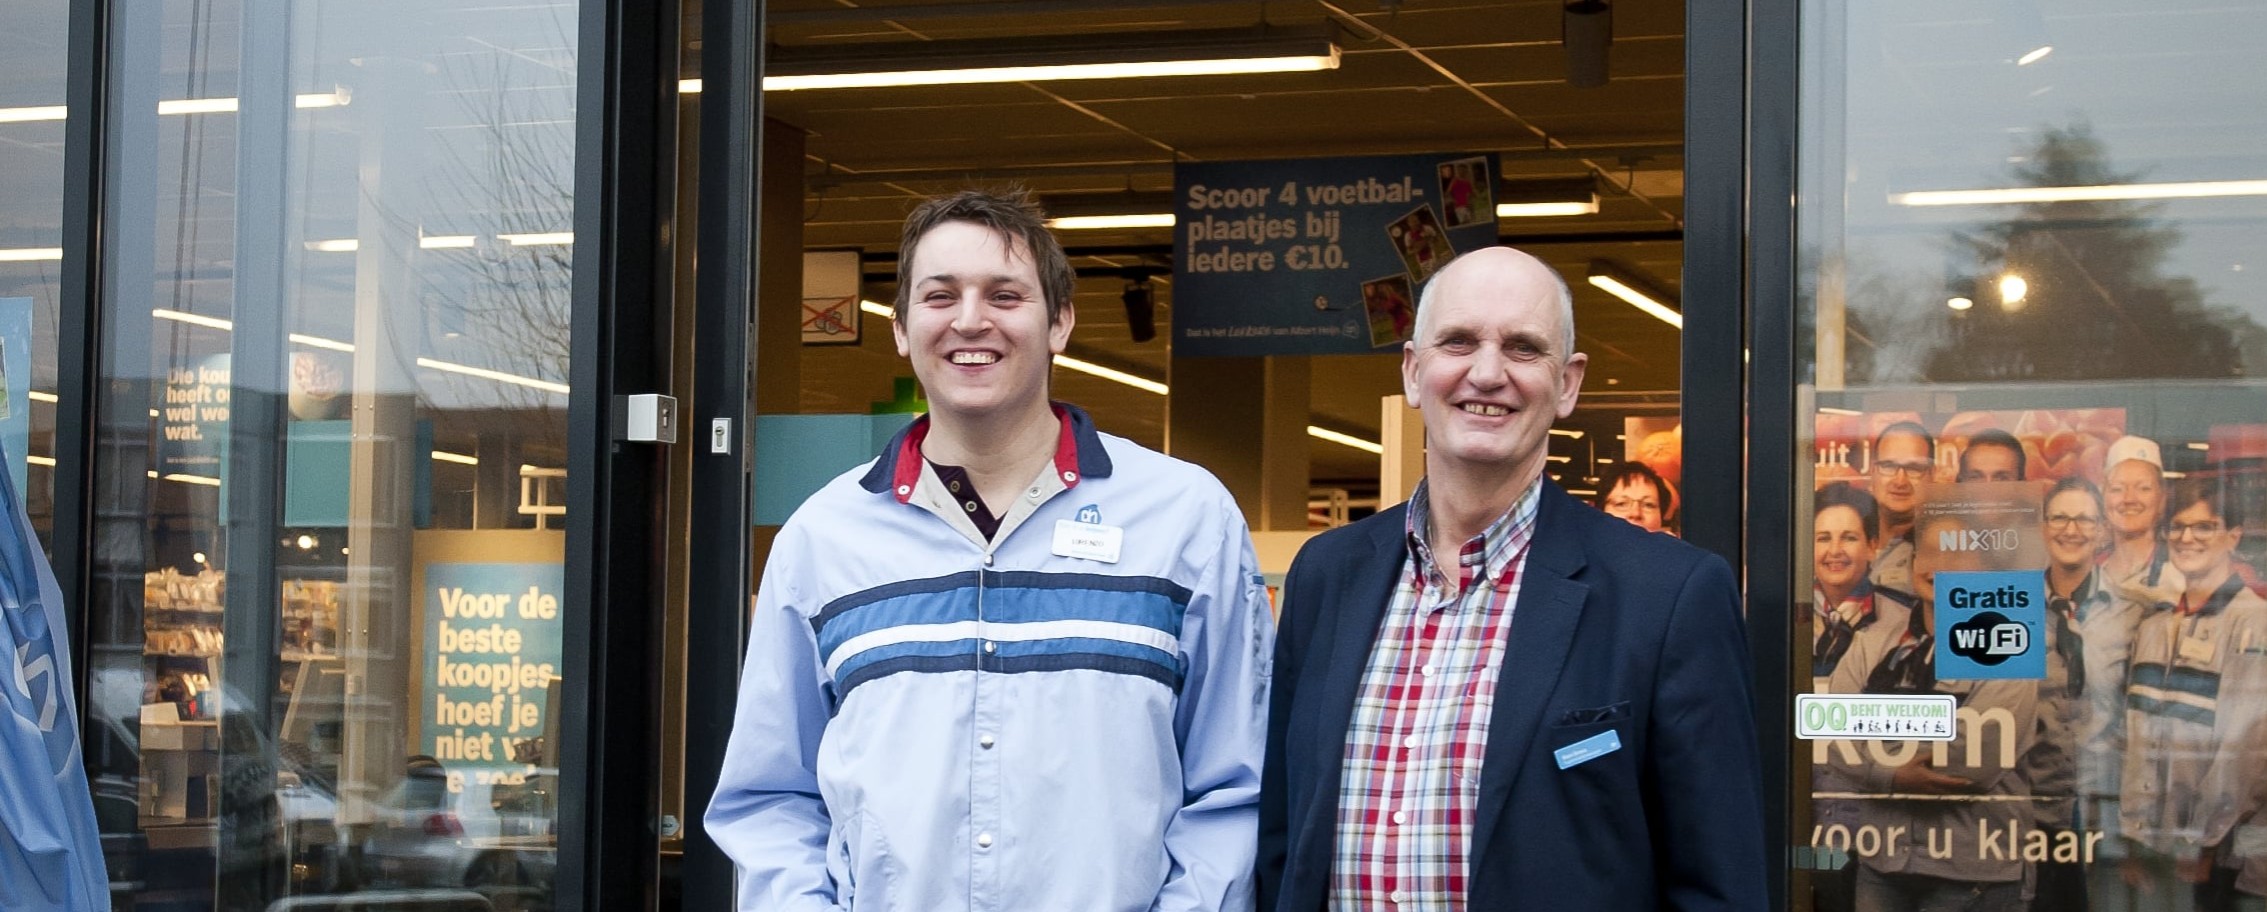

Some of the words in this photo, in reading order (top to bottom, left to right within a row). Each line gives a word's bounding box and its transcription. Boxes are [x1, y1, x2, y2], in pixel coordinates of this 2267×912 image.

[1187, 184, 1270, 209] Scoor
[1278, 181, 1297, 206] 4
[1306, 176, 1424, 205] voetbal-
[1187, 214, 1297, 245] plaatjes
[1306, 211, 1340, 245] bij
[1187, 246, 1275, 273] iedere
[1284, 244, 1349, 271] €10.
[166, 385, 212, 403] heeft
[166, 404, 196, 422] wel
[201, 407, 229, 422] we
[165, 424, 203, 441] wat.
[1939, 529, 2020, 552] NIX18
[439, 587, 511, 619] Voor
[518, 586, 557, 619] de
[1949, 585, 2030, 609] Gratis
[439, 620, 522, 653] beste
[437, 656, 554, 694] koopjes
[436, 693, 505, 726] hoef
[508, 694, 538, 733] je
[1851, 704, 1881, 718] BENT
[1886, 704, 1947, 718] WELKOM!
[435, 729, 493, 760] niet
[1928, 827, 1953, 859] u
[1978, 818, 2105, 864] klaar
